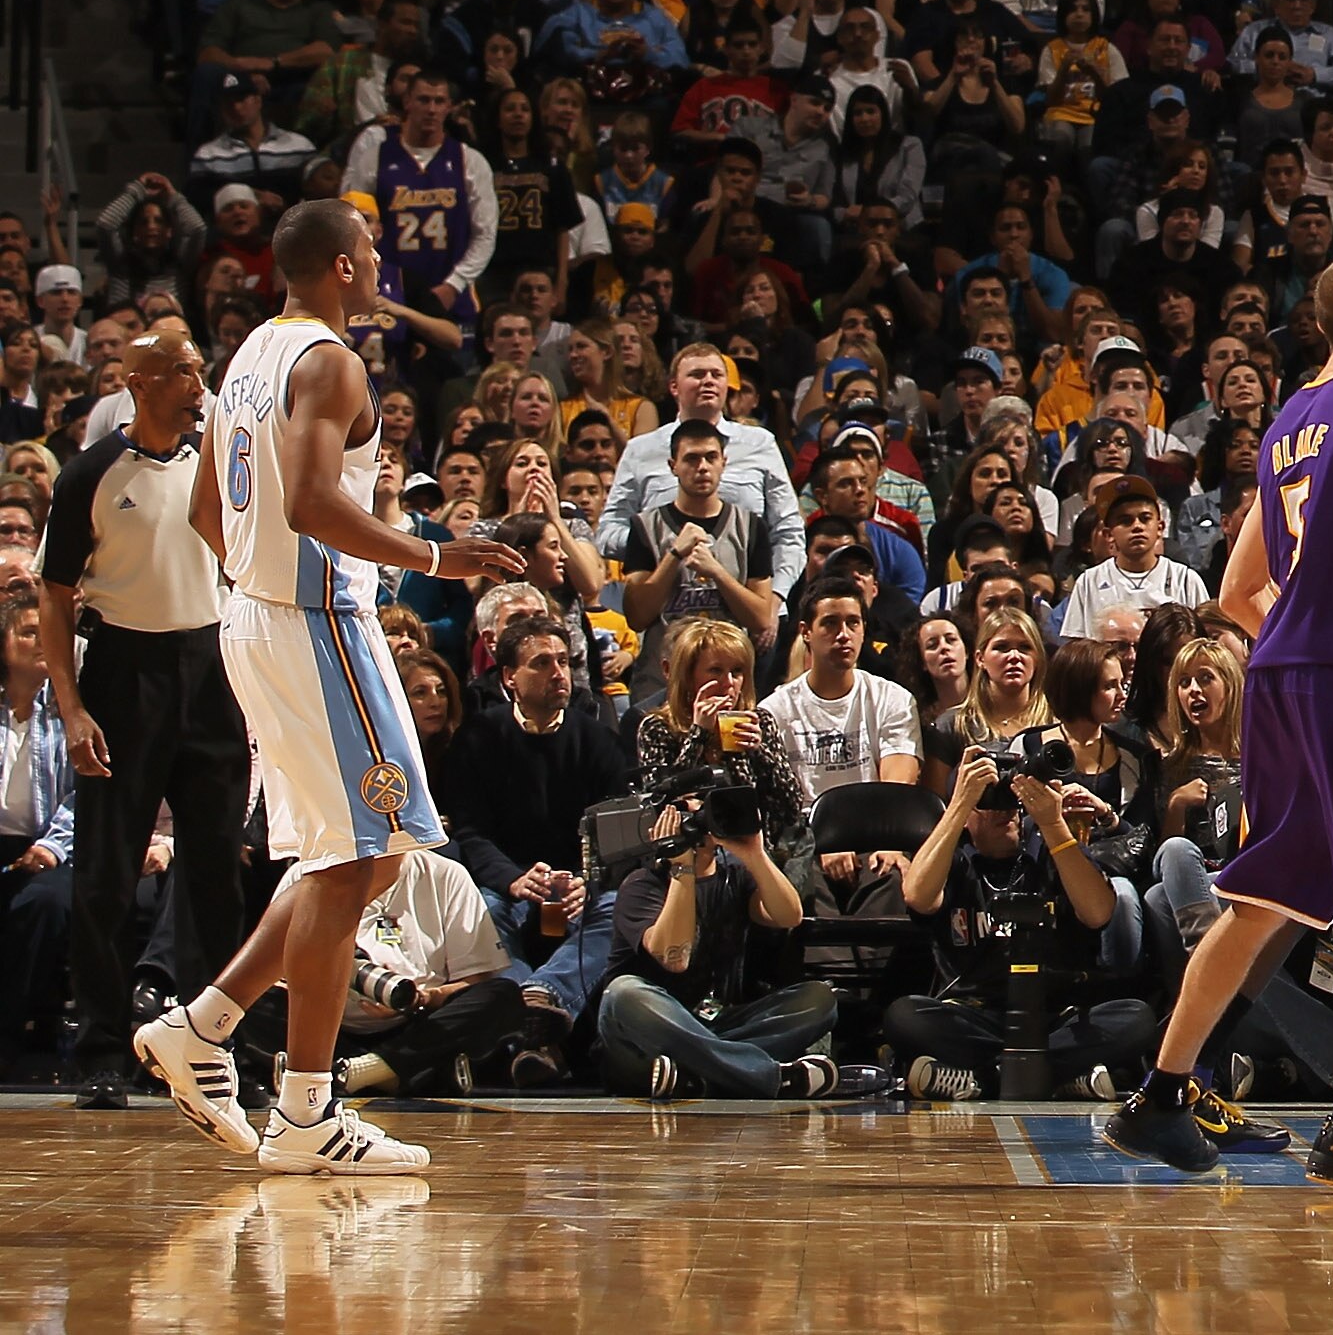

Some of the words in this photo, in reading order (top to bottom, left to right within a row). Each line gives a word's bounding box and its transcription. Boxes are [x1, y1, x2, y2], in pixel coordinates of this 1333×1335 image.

[396, 211, 450, 252] 24
[500, 188, 544, 231] 24
[228, 426, 253, 514] 6
[1279, 474, 1313, 583] 5
